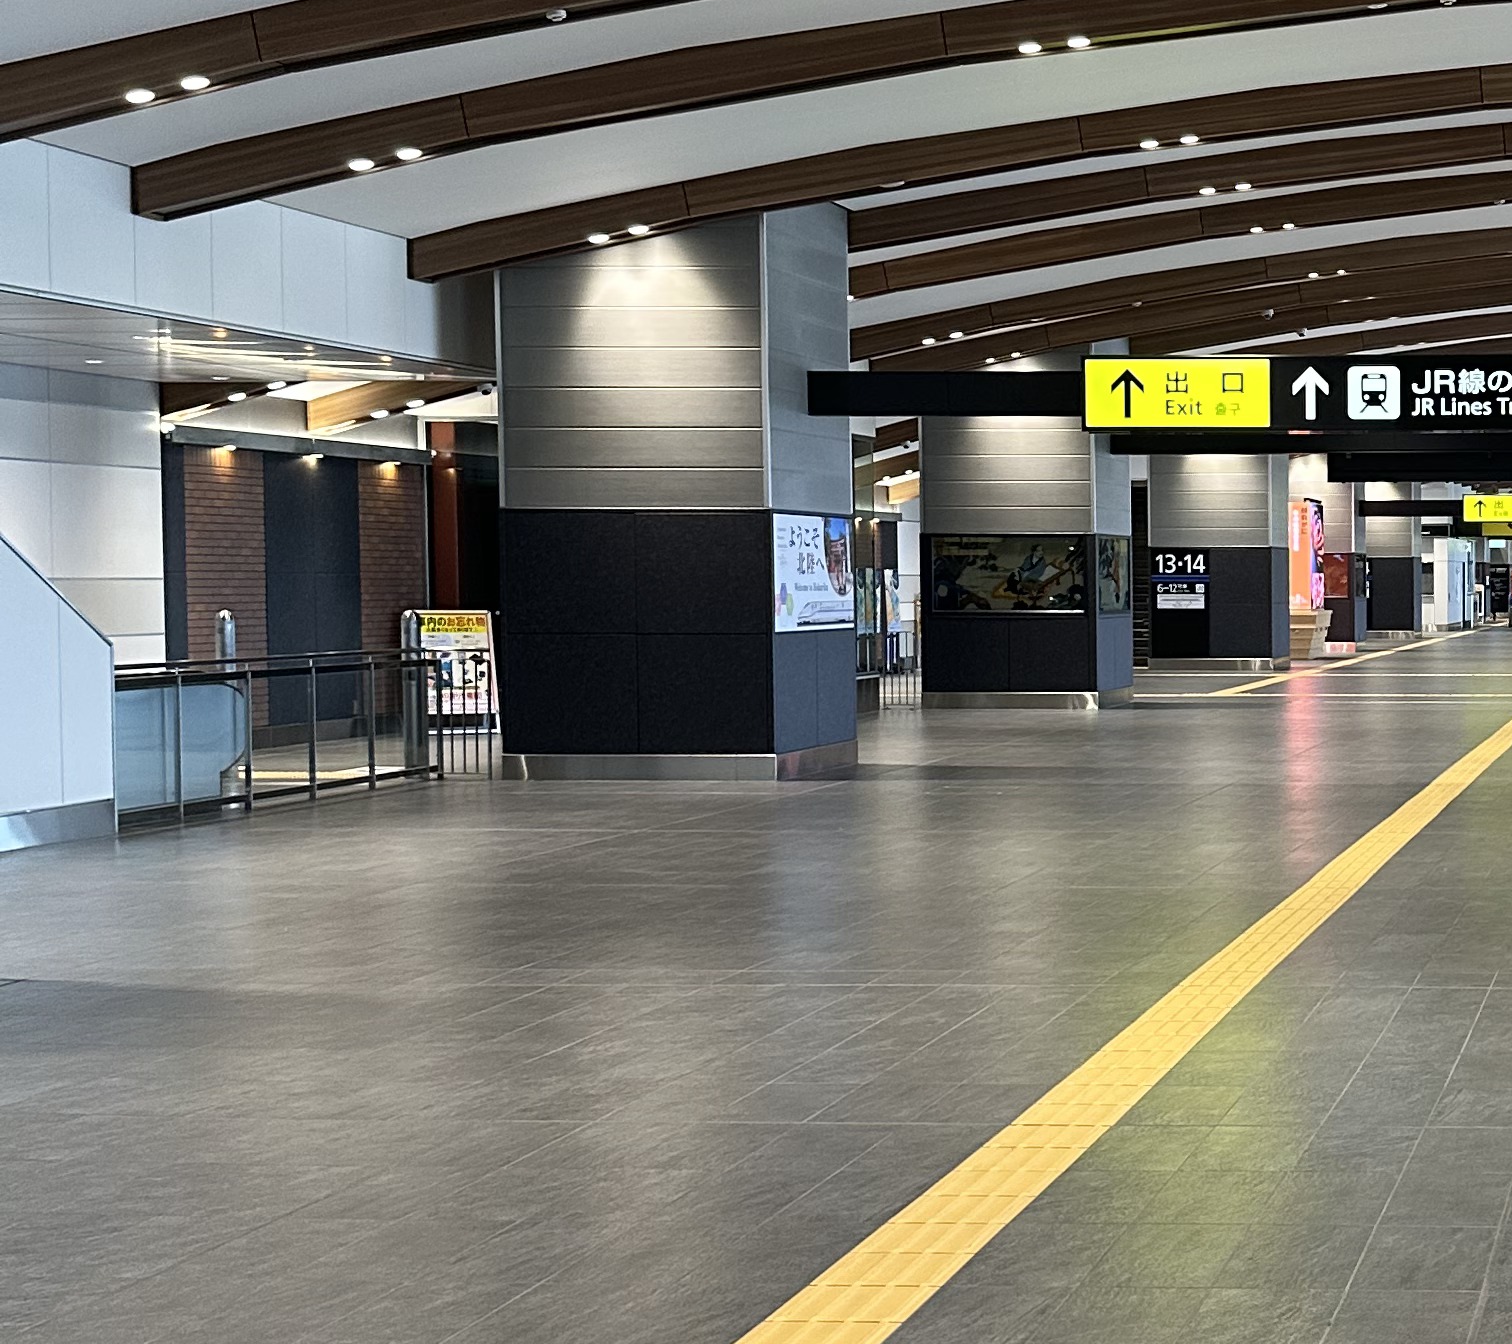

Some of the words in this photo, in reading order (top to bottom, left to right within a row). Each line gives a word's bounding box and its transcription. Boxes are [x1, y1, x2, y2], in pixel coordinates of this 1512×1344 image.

[1165, 370, 1244, 394] 出口
[1165, 398, 1203, 416] Exit
[1411, 397, 1435, 416] JR
[1440, 397, 1492, 416] Lines
[788, 525, 820, 550] ようこそ
